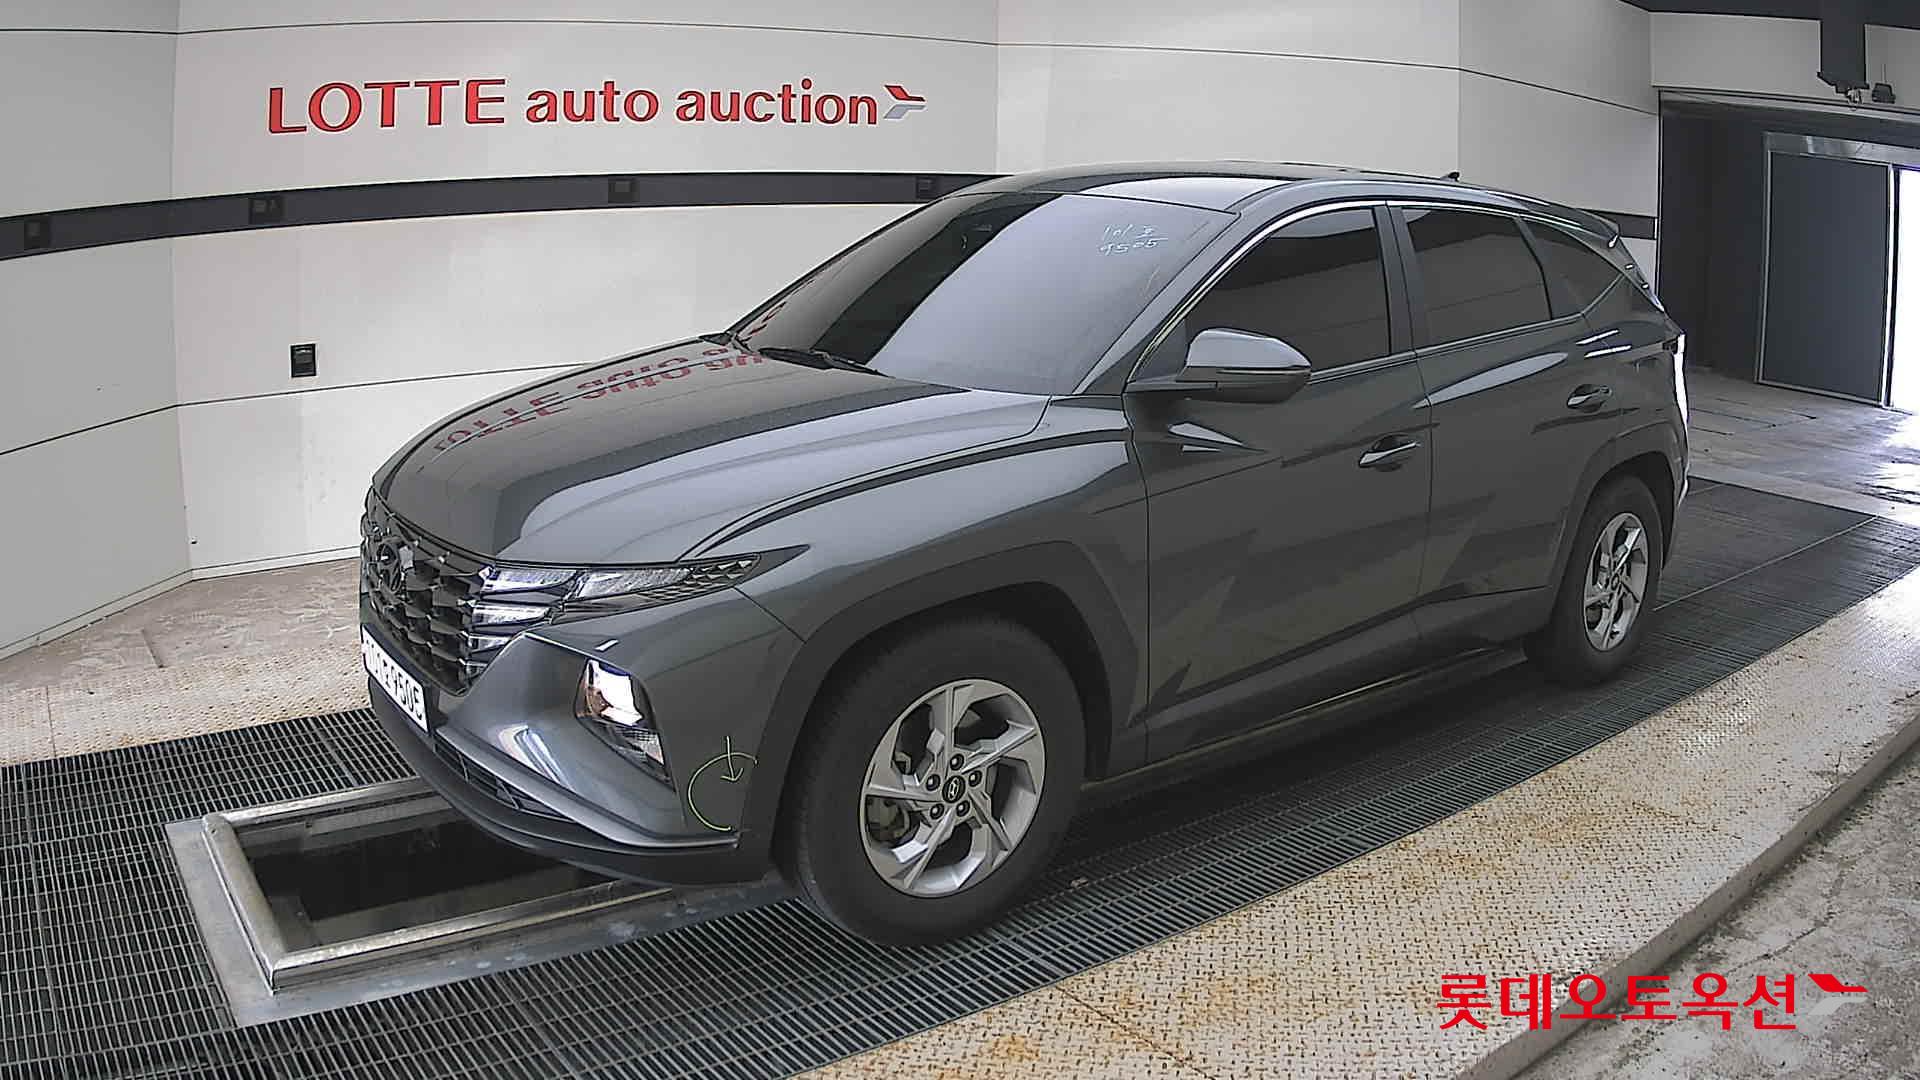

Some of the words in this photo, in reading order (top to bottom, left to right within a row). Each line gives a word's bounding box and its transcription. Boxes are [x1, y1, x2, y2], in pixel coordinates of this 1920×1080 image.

[267, 78, 505, 134] LOTTE
[525, 80, 660, 123] auto
[675, 78, 878, 125] auction
